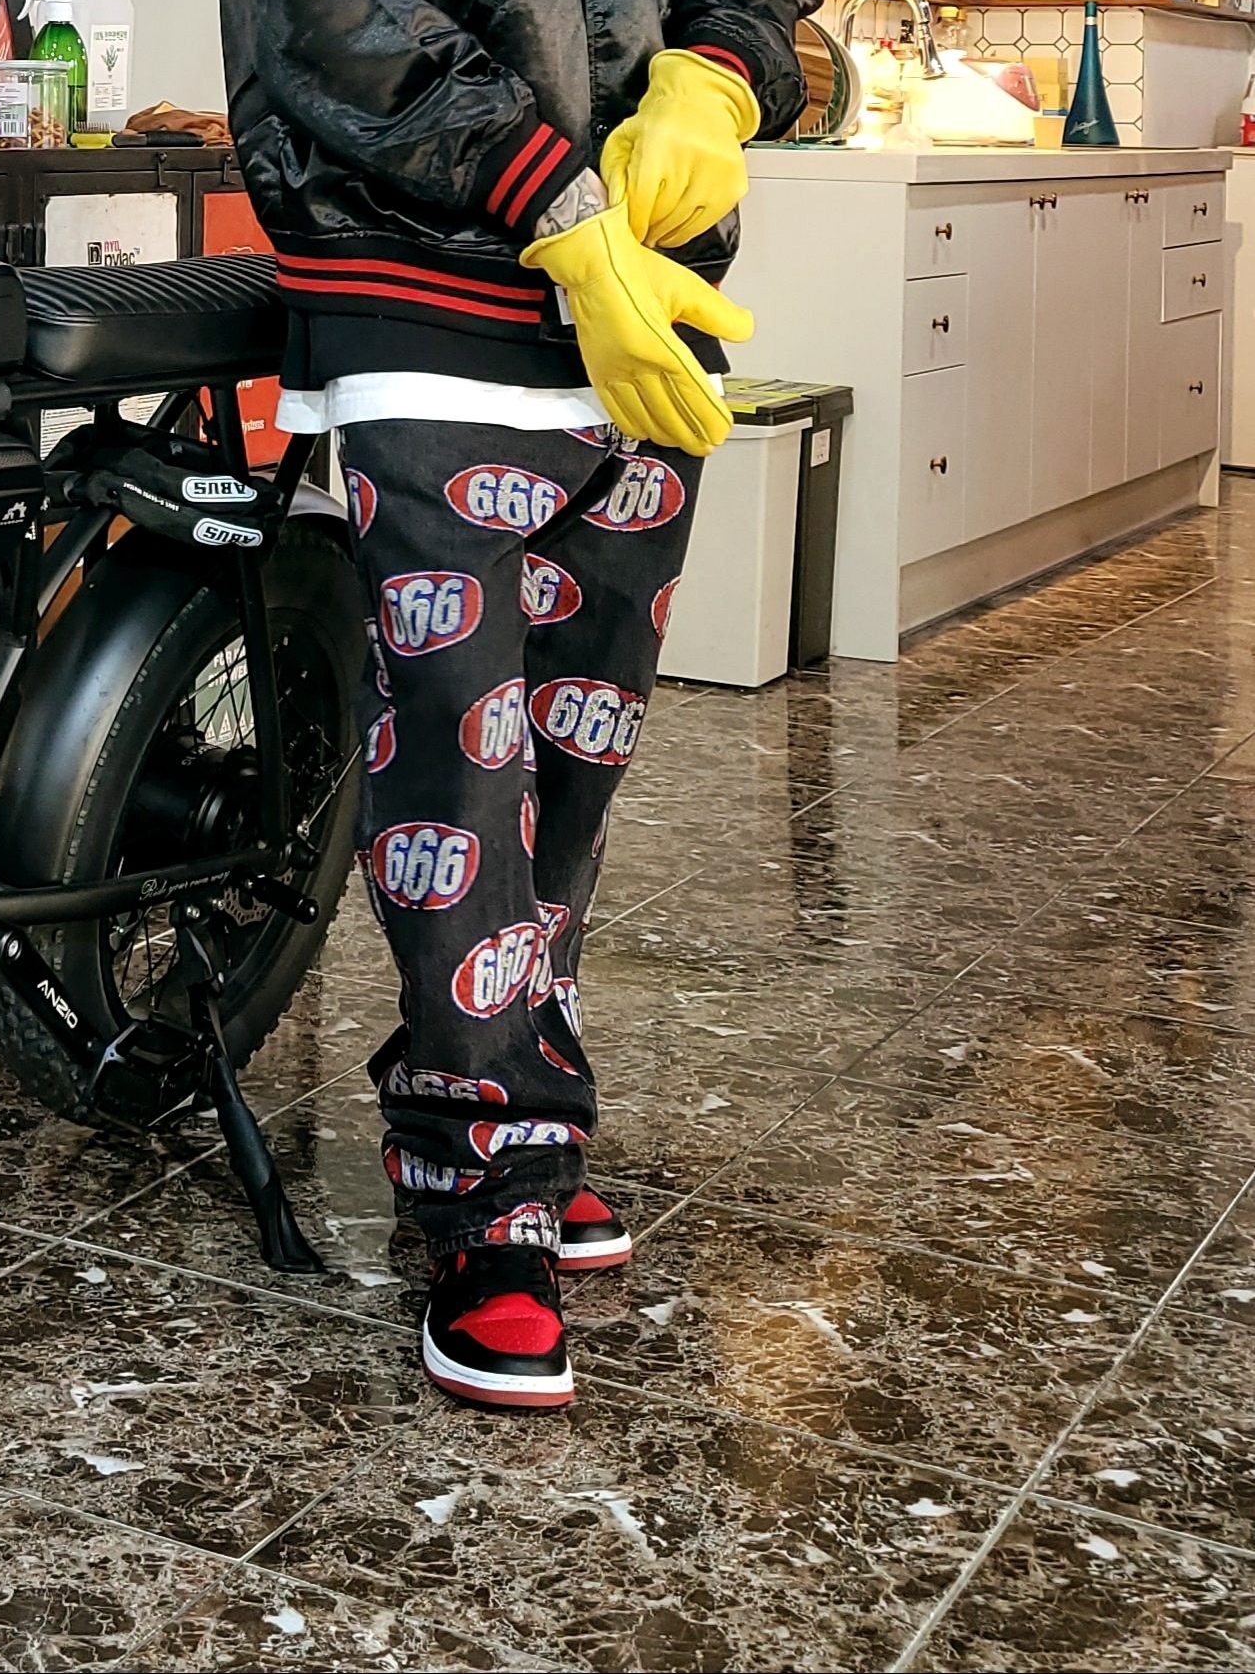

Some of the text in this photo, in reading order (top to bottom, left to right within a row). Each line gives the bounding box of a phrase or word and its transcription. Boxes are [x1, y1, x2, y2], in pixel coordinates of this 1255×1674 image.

[194, 482, 247, 495] ABUS
[468, 471, 558, 528] 666
[592, 462, 665, 523] 66
[203, 526, 257, 543] ABUS
[384, 577, 464, 648] 666
[546, 684, 645, 757] 666
[139, 878, 168, 901] Ride
[165, 881, 189, 898] your
[385, 828, 469, 901] 666
[473, 927, 535, 1010] 666
[36, 978, 79, 1030] ANZIO
